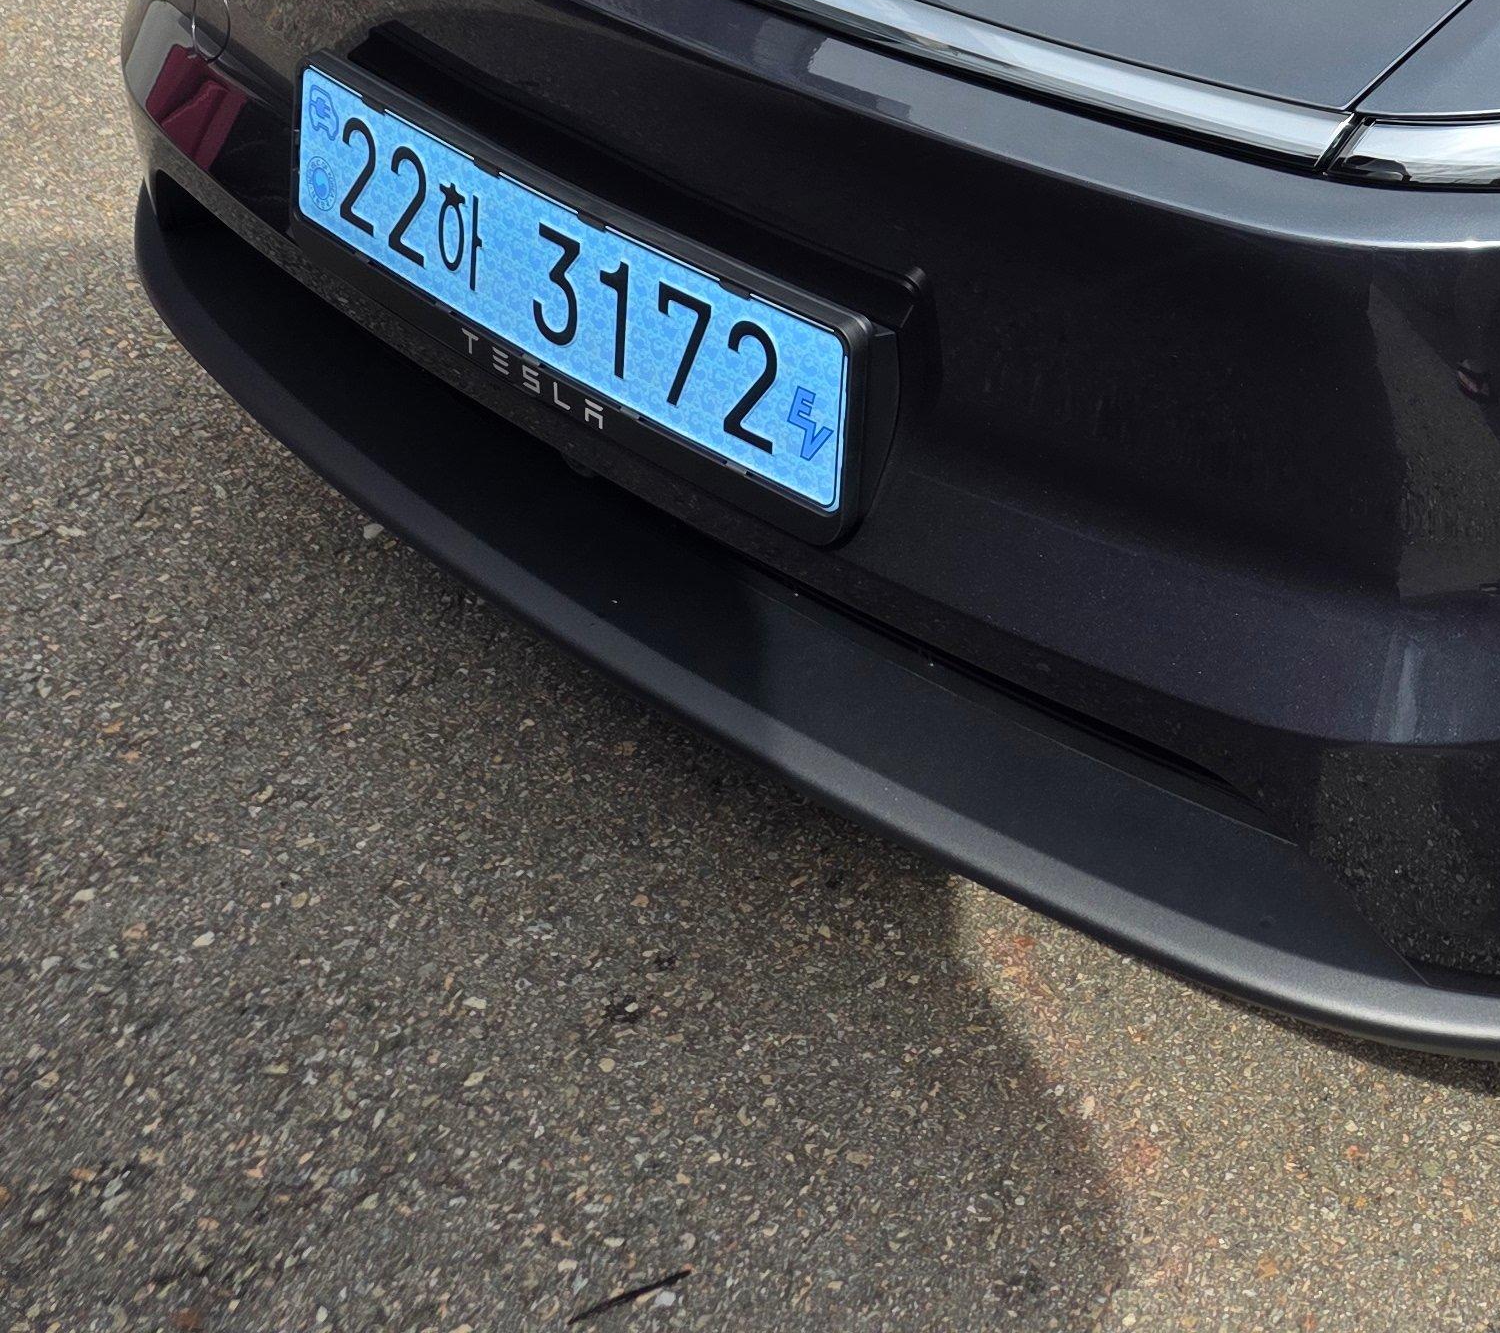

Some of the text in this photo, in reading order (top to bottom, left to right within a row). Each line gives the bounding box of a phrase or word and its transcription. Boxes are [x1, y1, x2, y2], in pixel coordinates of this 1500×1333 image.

[339, 117, 779, 455] 22하 3172
[461, 328, 605, 430] TESLA
